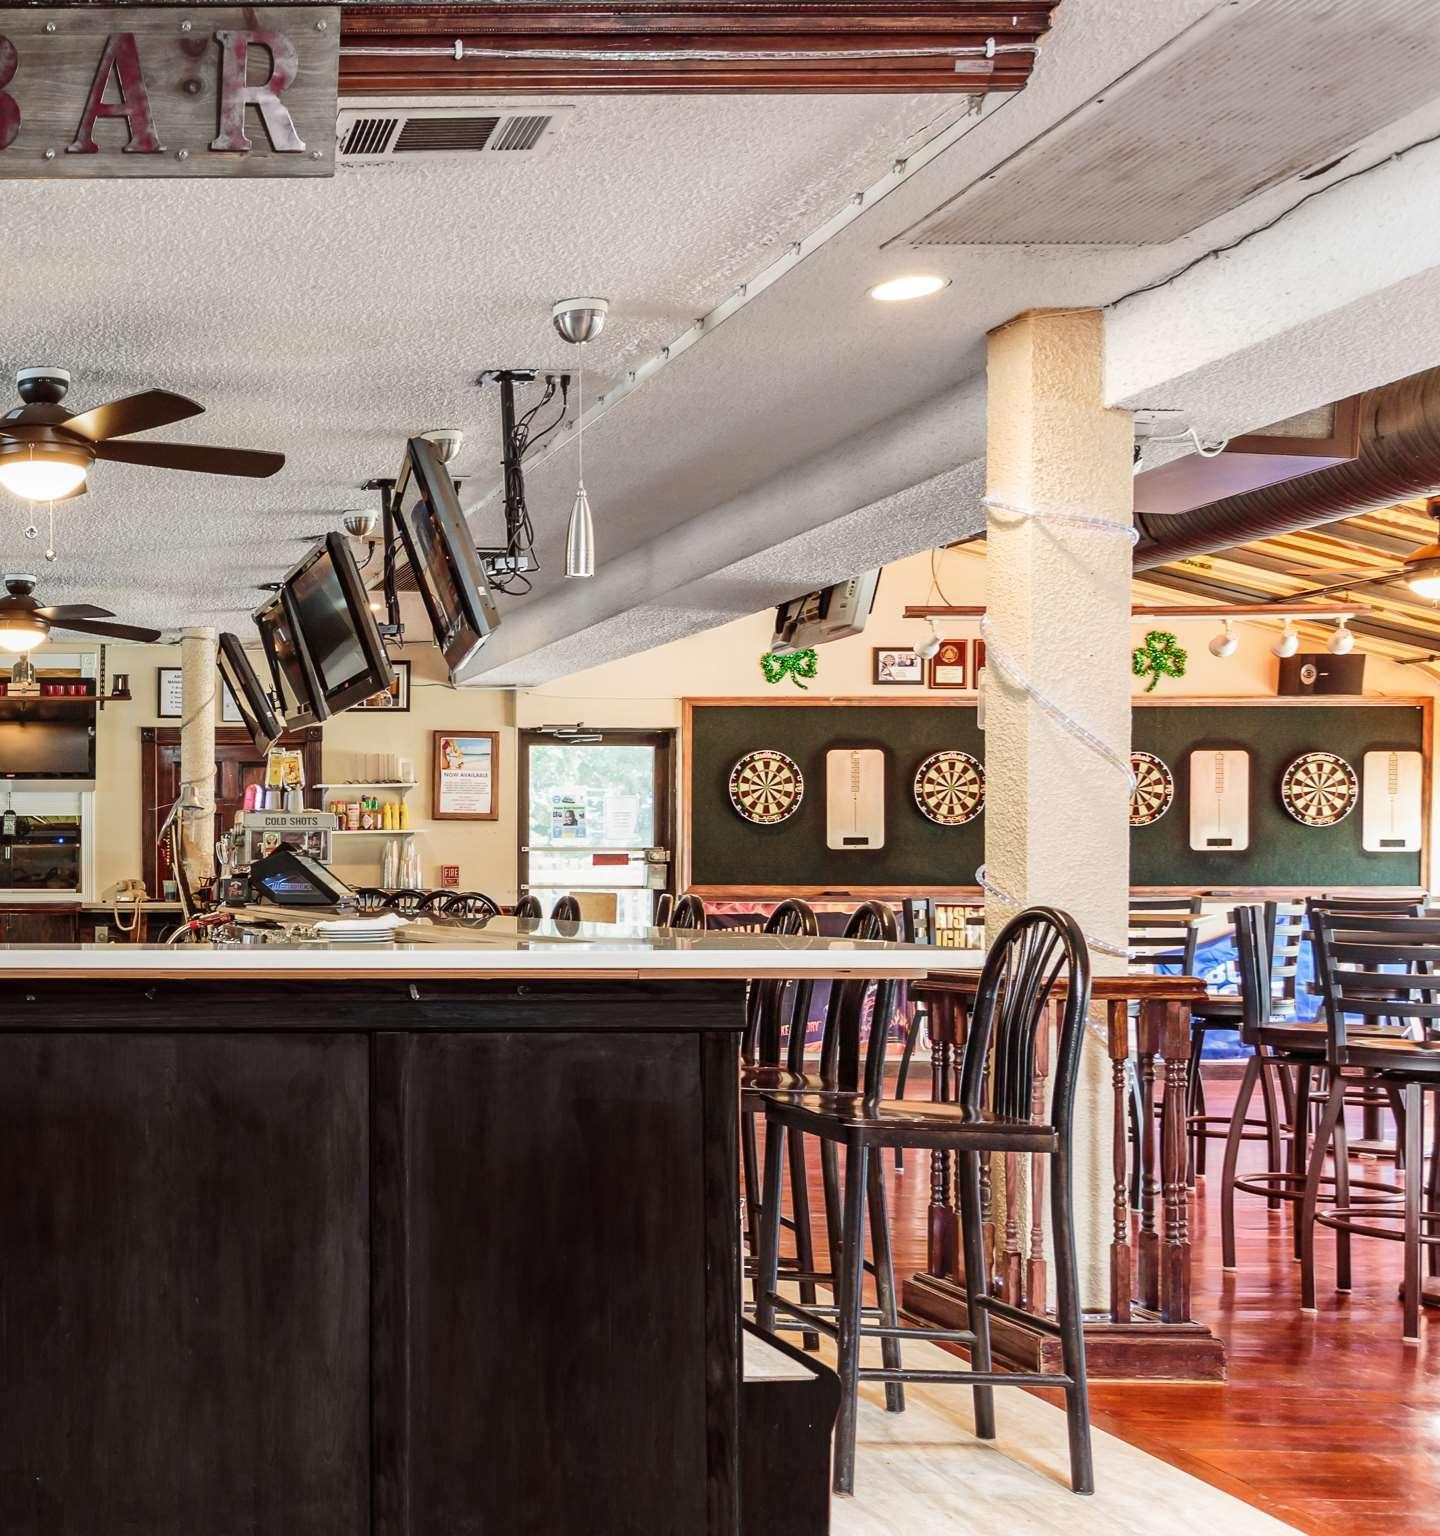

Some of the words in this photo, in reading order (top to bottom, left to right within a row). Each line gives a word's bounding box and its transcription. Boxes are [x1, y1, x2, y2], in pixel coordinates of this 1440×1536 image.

[265, 817, 287, 826] COLD
[289, 817, 318, 826] SHOTS
[444, 868, 459, 877] FIRE
